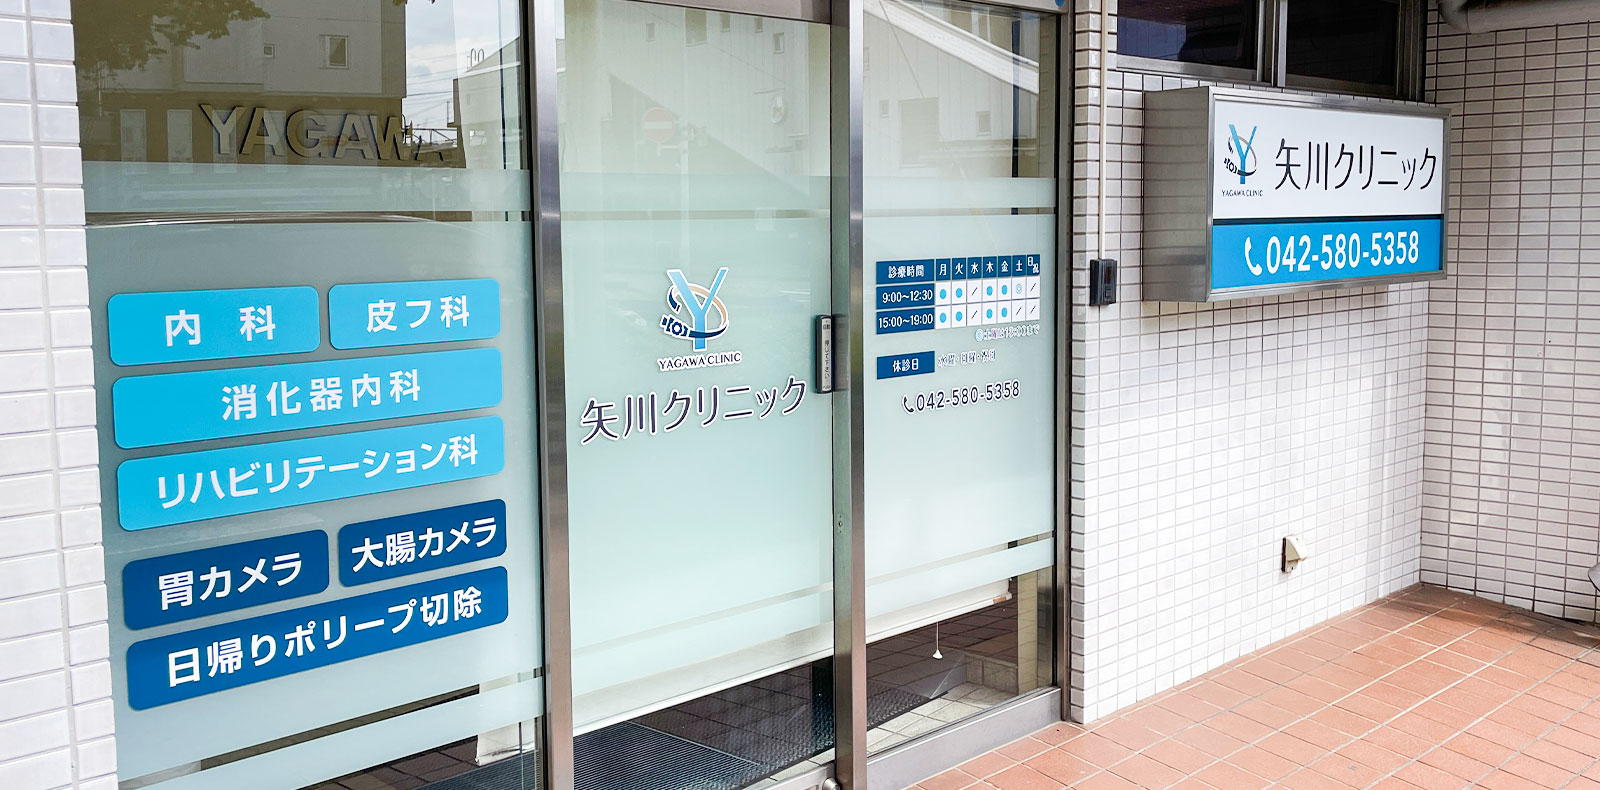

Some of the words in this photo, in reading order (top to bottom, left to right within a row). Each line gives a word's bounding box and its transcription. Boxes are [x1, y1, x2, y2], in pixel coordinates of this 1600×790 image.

[1275, 138, 1437, 191] 矢川クリニック
[888, 264, 925, 279] 診療時間
[939, 263, 947, 276] 月
[955, 262, 964, 275] 火
[970, 262, 979, 274] 水
[986, 261, 994, 273] 木
[1000, 260, 1009, 272] 金
[1016, 260, 1023, 271] 土
[1267, 230, 1419, 274] 042-580-5358
[366, 296, 471, 334] 皮フ科
[659, 358, 705, 370] YAGAWA
[707, 353, 742, 366] CLINIC
[892, 358, 919, 373] 休診日
[222, 369, 421, 421] 消化器内科
[582, 378, 806, 443] 矢川クリニック
[916, 380, 1020, 411] 042-580-5358
[158, 434, 478, 509] リハビリテーション科
[352, 517, 498, 573] 大腸カメラ
[158, 552, 302, 611] 胃カメラ
[168, 586, 482, 688] 日帰りポリープ切除
